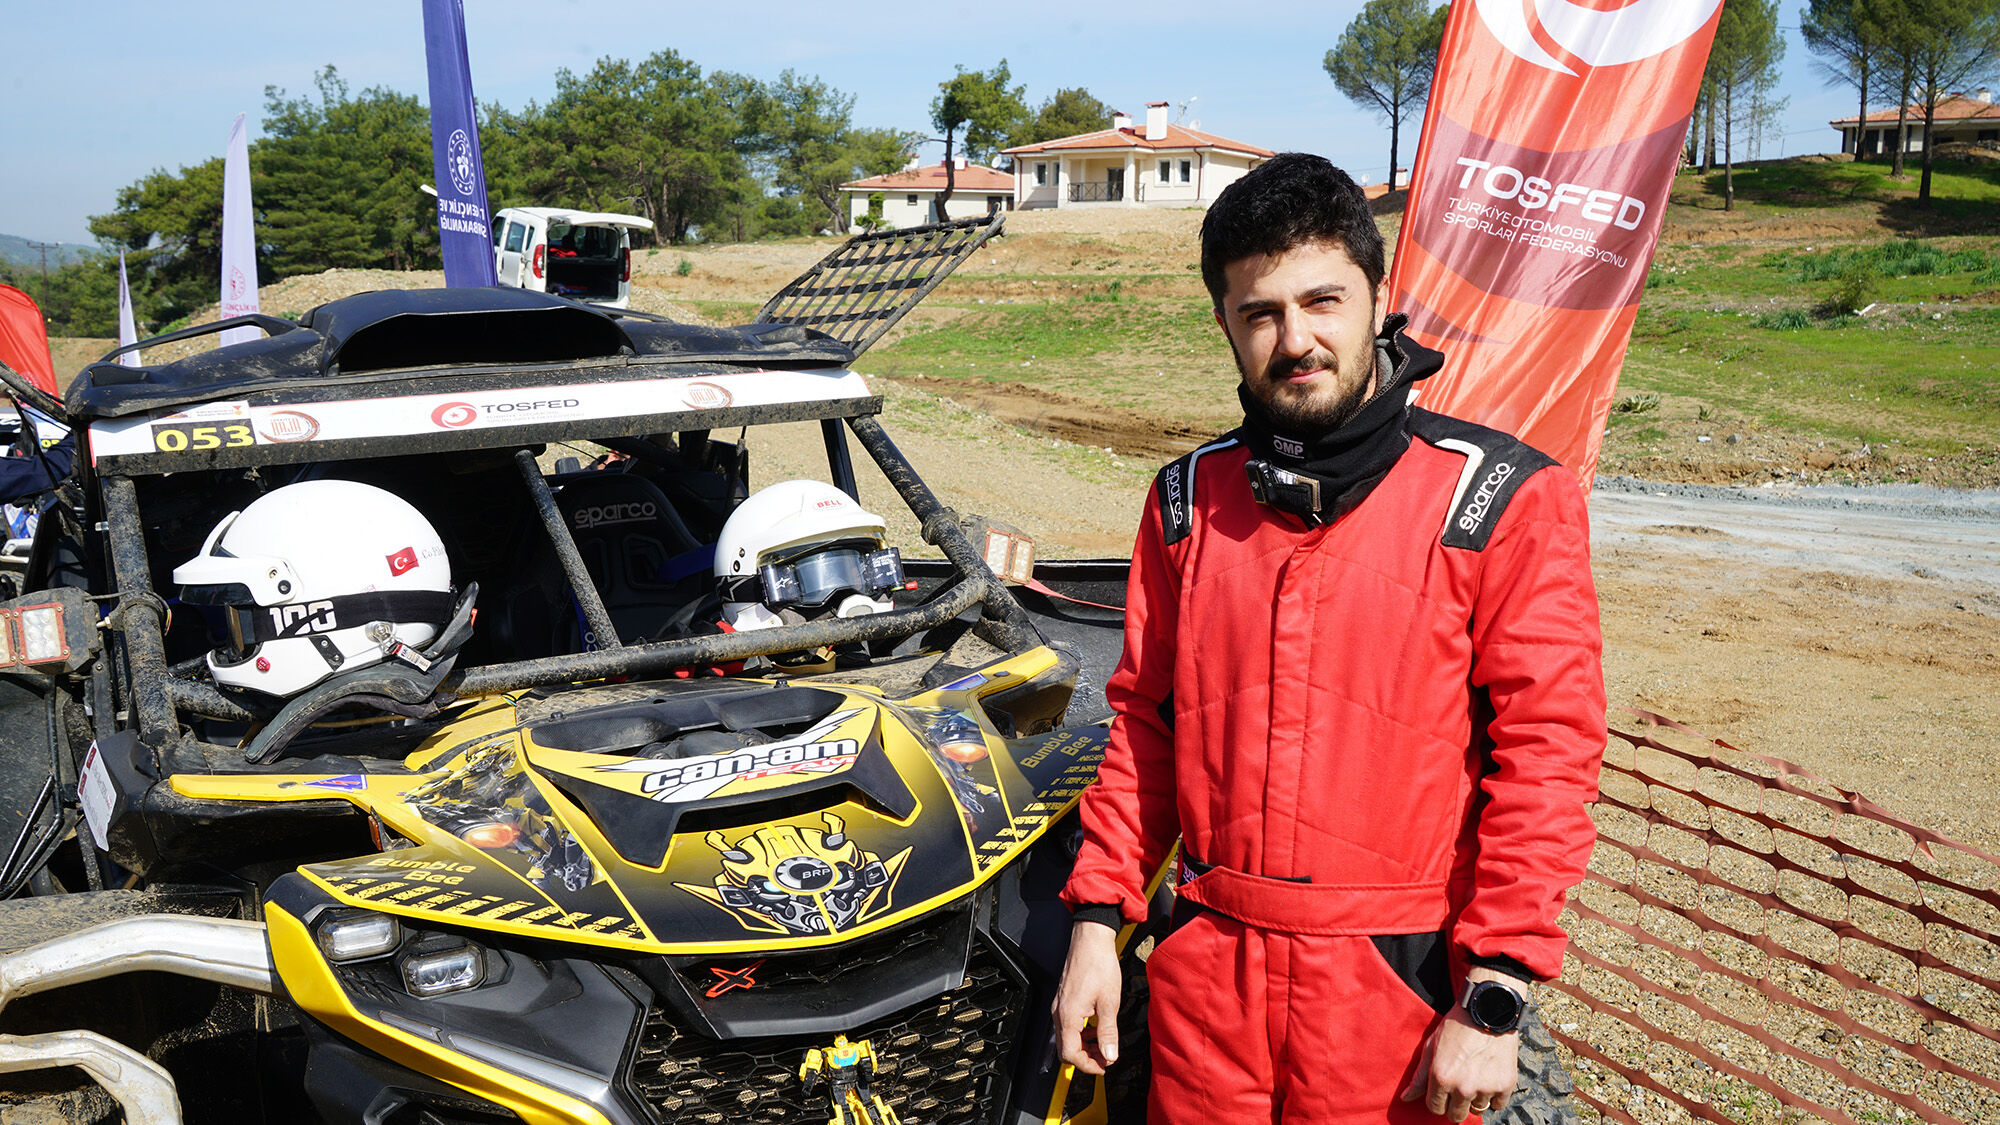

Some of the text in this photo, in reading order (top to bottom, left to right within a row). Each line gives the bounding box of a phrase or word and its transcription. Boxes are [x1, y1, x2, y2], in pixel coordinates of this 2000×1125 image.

[1457, 157, 1646, 231] TOSFED
[1449, 197, 1597, 243] TÜRKİYE OTOMOBİL
[1443, 211, 1628, 268] SPORLARI FEDERASYONU
[481, 399, 580, 413] TOSFED
[155, 425, 254, 452] 053
[1273, 439, 1304, 455] OMP
[817, 499, 843, 508] BELL
[1165, 464, 1183, 525] sparco
[1459, 463, 1512, 532] sparco
[575, 502, 657, 528] sparco
[1020, 732, 1073, 769] Bumble
[1060, 735, 1093, 757] Bee
[641, 739, 858, 793] can-am
[737, 756, 857, 781] TEAM
[367, 858, 477, 873] Bumble
[403, 870, 465, 885] Bee
[802, 868, 831, 879] BRP
